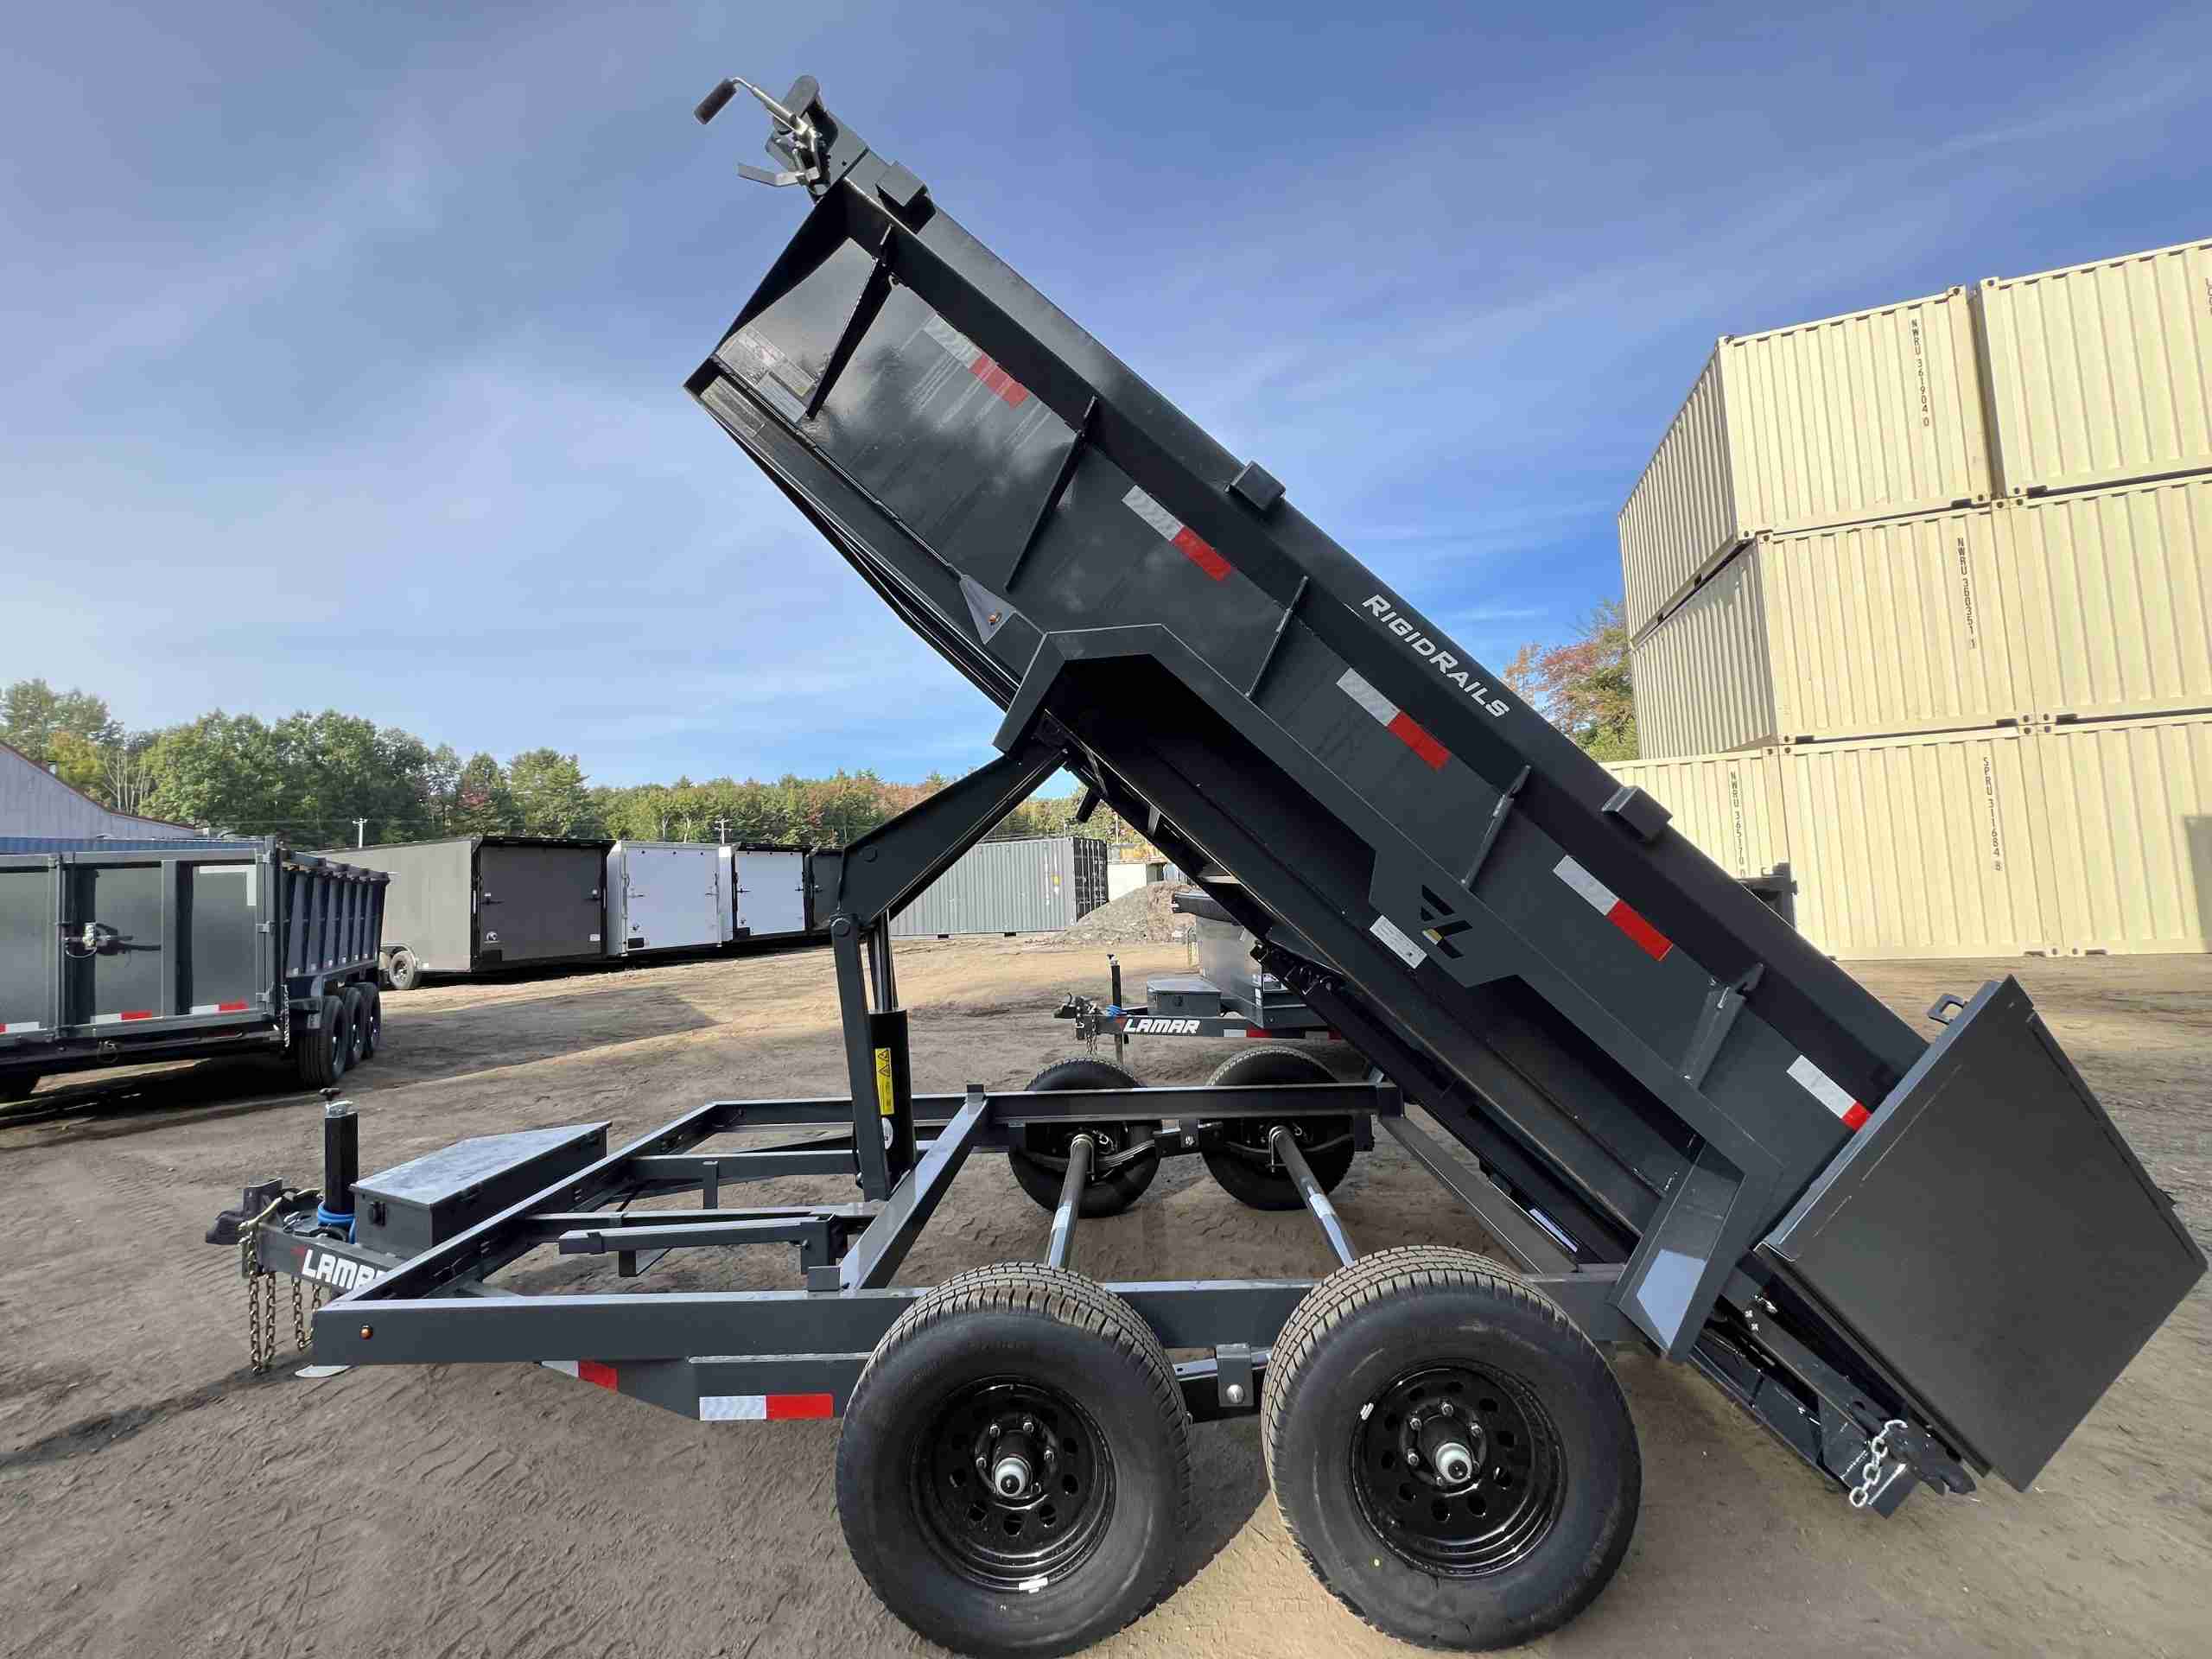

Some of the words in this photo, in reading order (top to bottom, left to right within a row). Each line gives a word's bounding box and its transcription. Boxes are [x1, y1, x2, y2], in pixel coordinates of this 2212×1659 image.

[1911, 319, 1921, 355] NWRU
[1916, 359, 1929, 412] 361904
[1956, 537, 1967, 575] NWRU
[1362, 594, 1510, 717] RIGIDRAILS
[1983, 757, 1993, 795] SPRU
[1988, 798, 2000, 857] 311684
[1123, 1018, 1200, 1034] LAMAR
[302, 1249, 388, 1290] LAMA
